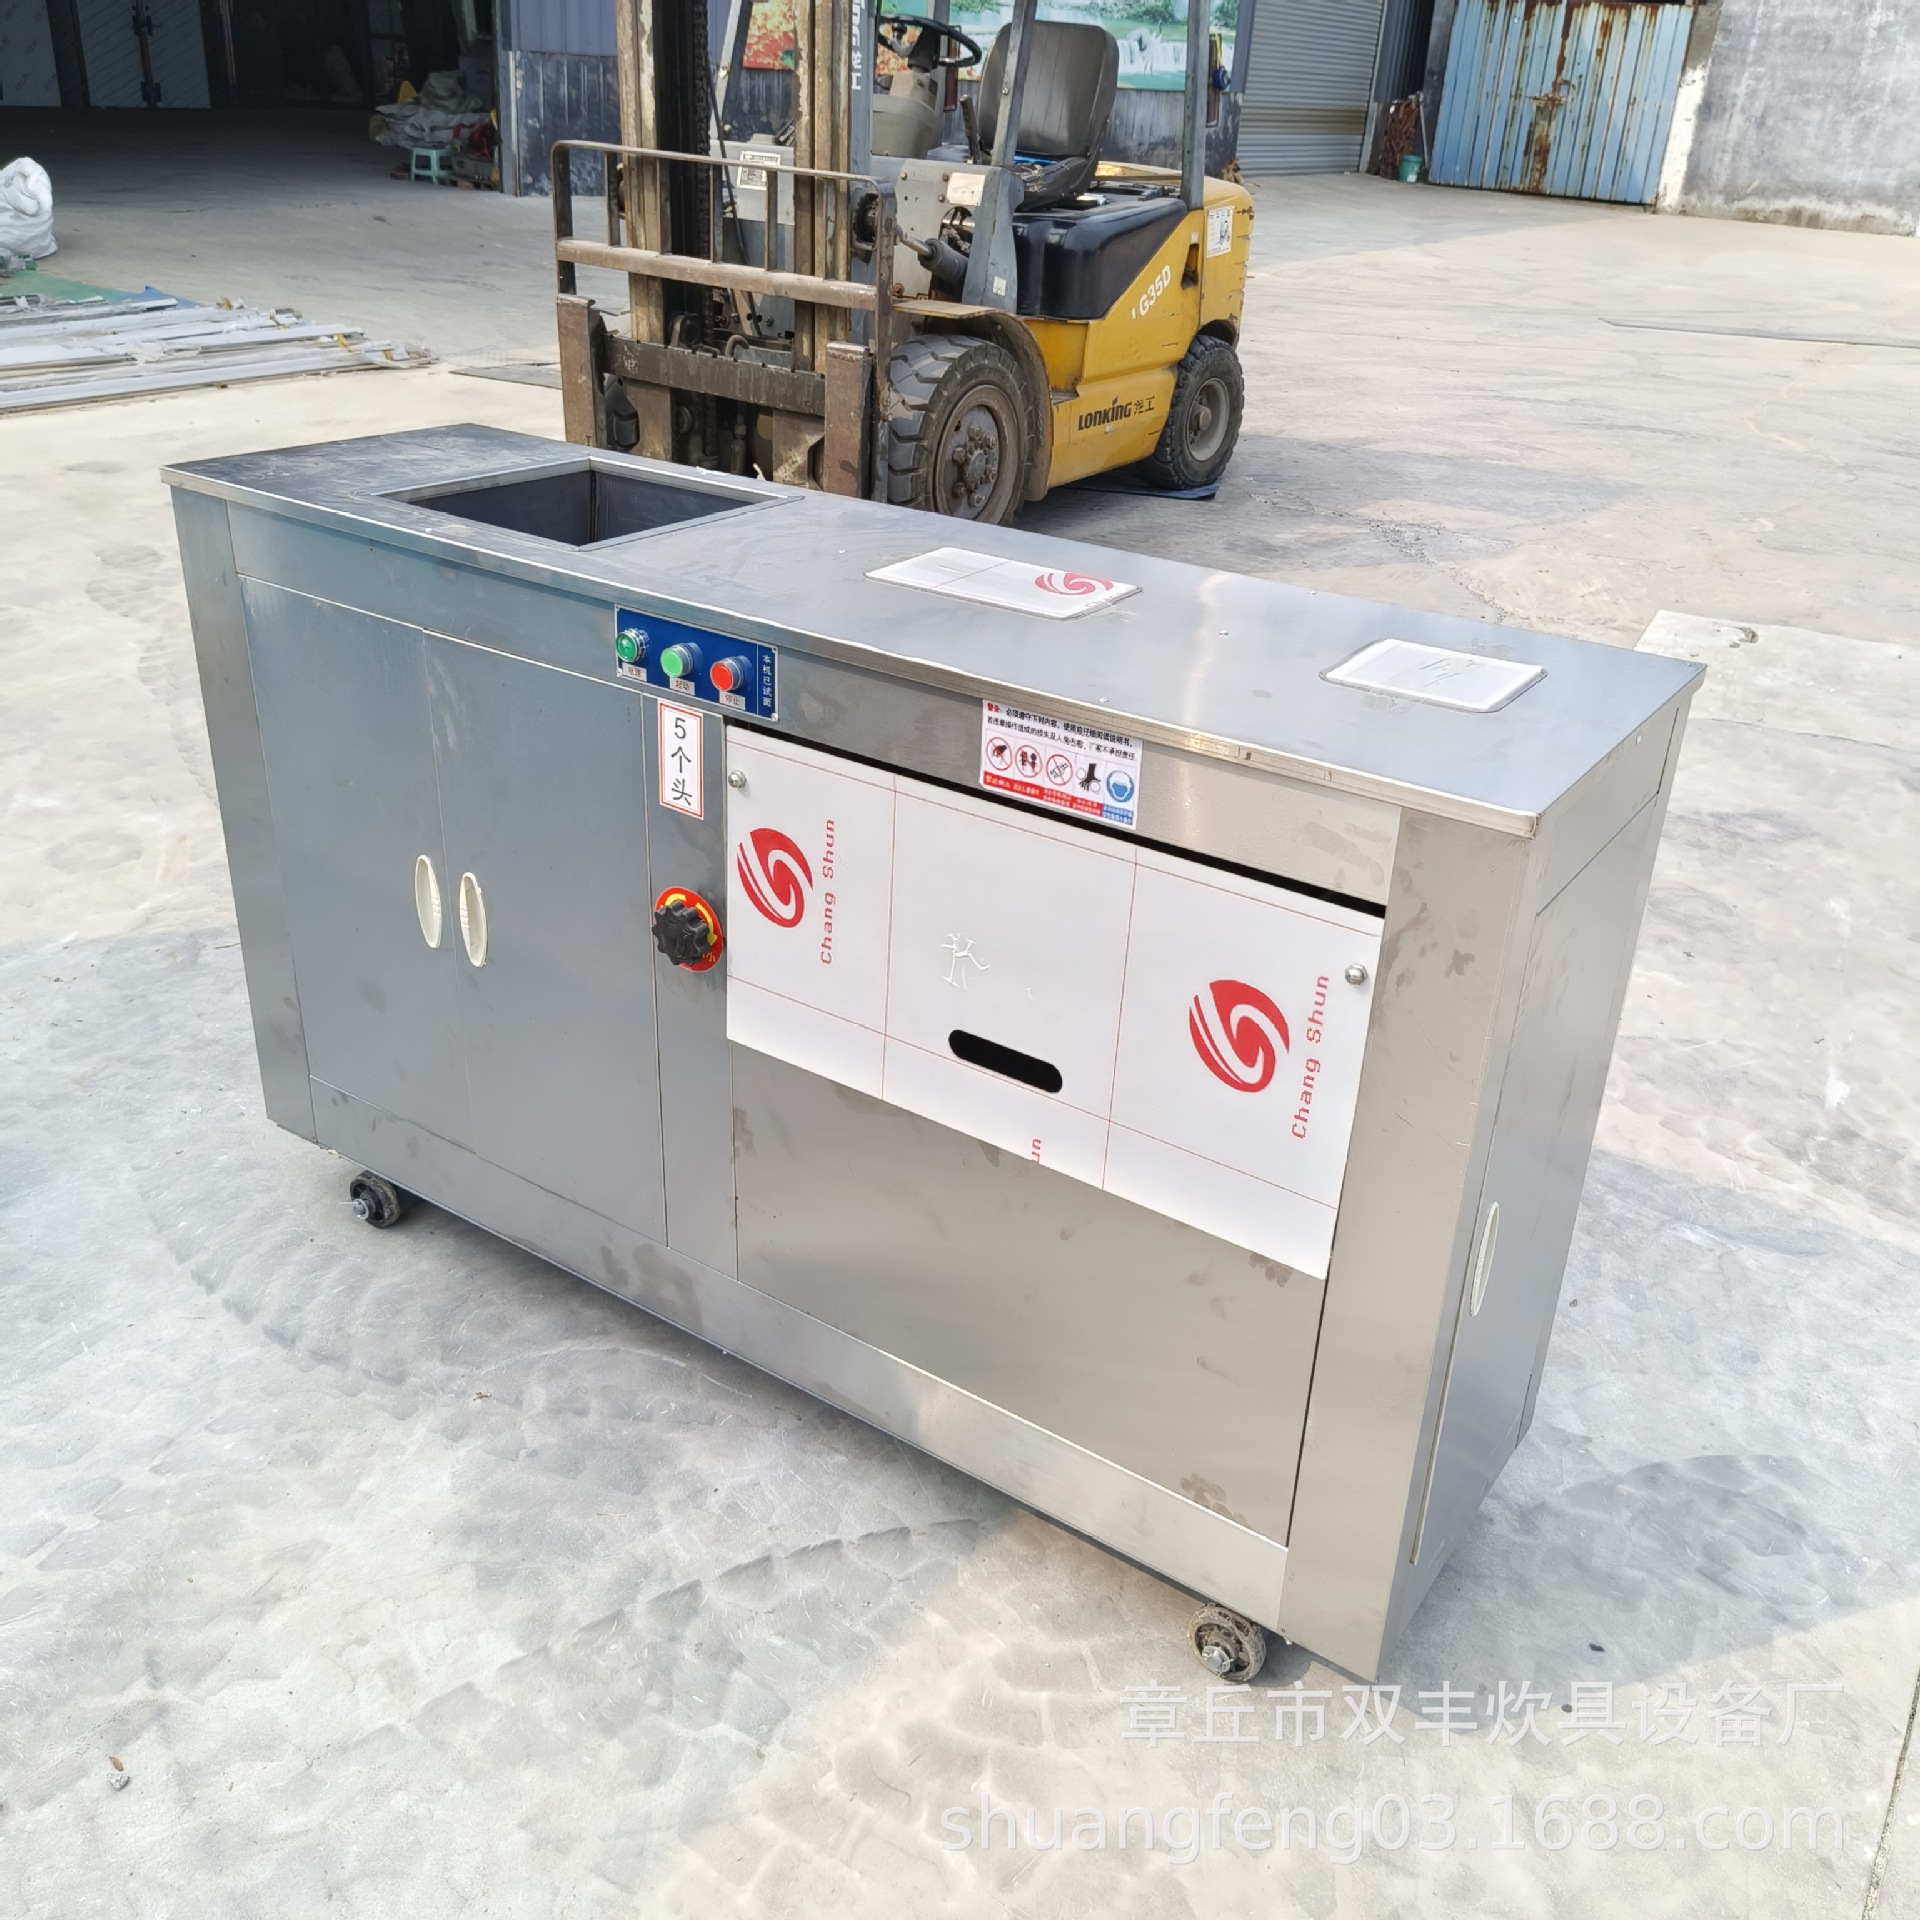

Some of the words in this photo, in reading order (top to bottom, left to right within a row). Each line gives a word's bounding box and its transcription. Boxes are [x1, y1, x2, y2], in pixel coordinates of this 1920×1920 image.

[724, 693, 741, 706] 停止
[762, 654, 773, 708] 本机已试面
[670, 716, 693, 806] 5个头
[822, 819, 835, 879] Shun
[820, 892, 837, 965] Chang
[1291, 1058, 1321, 1139] Chang
[1306, 976, 1329, 1044] Shun
